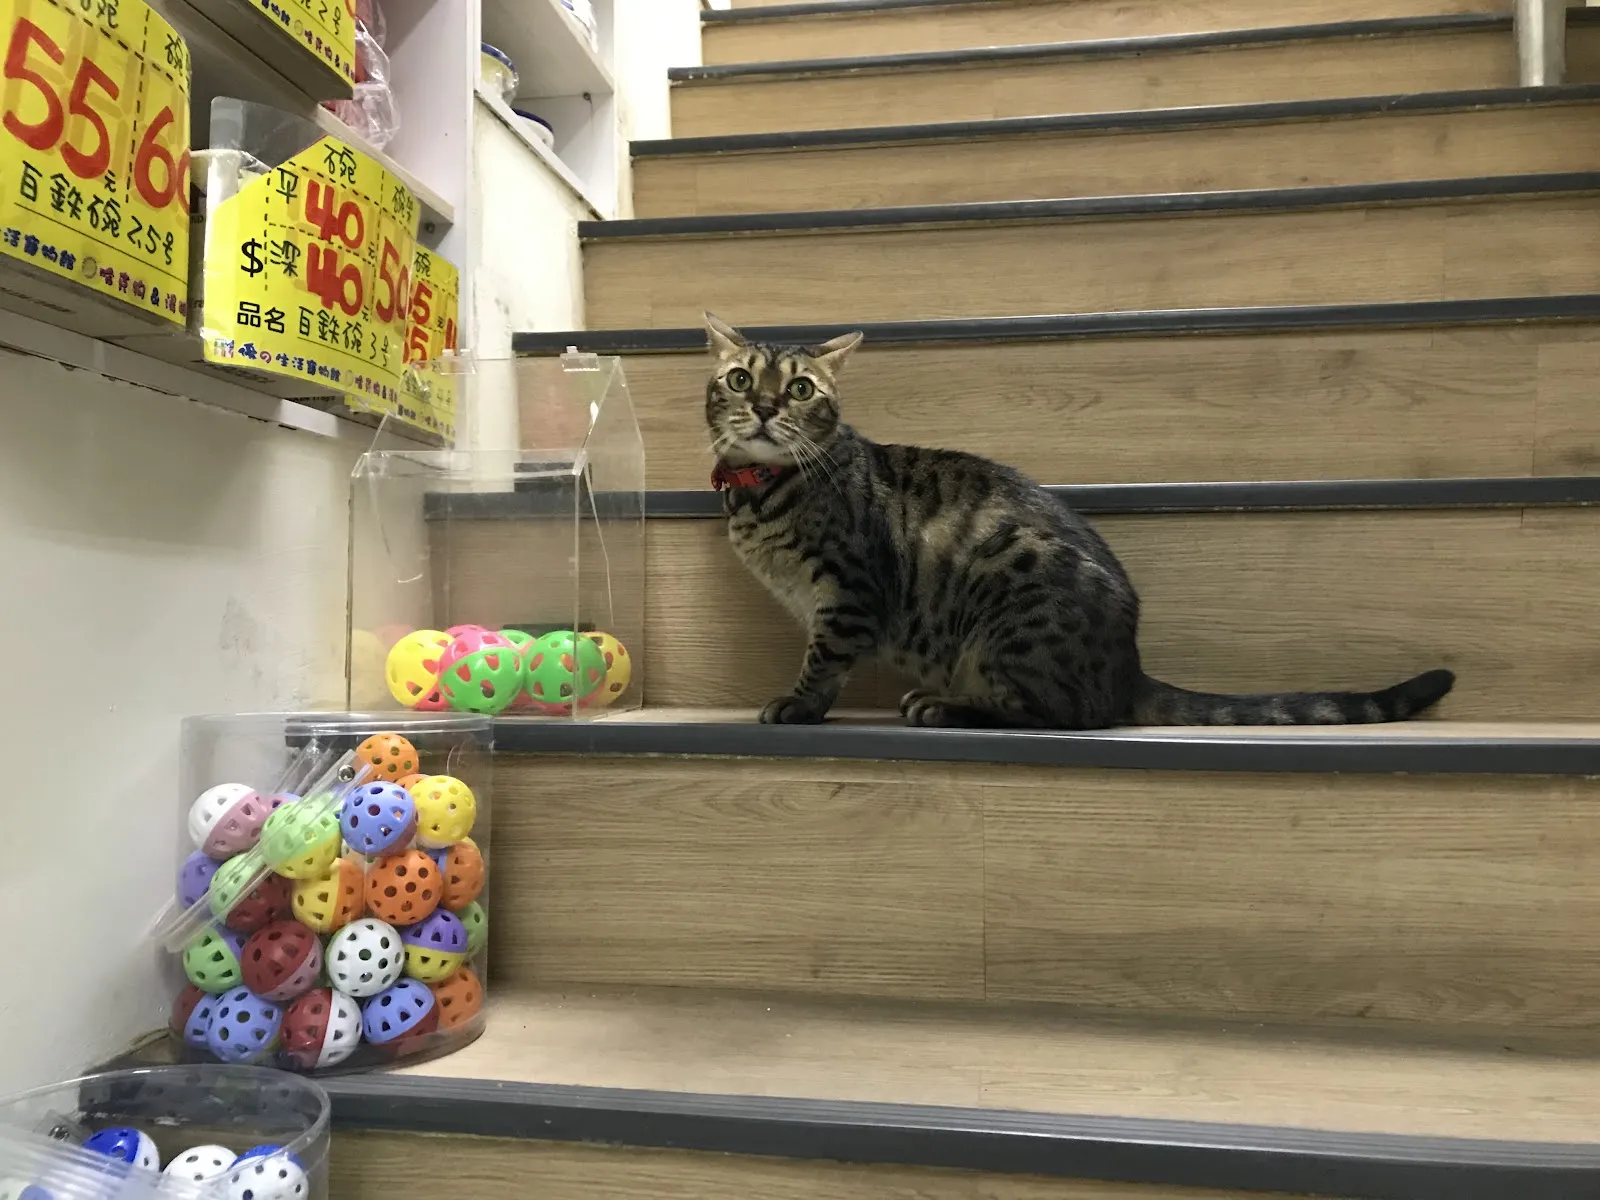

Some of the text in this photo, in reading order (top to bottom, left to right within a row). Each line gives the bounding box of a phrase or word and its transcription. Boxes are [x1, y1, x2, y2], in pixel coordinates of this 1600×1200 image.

[3, 16, 120, 179] 55
[324, 144, 357, 184] 碗
[276, 167, 298, 205] 平
[305, 178, 365, 250] 40
[240, 238, 264, 278] $
[306, 242, 364, 317] 40
[236, 300, 286, 335] 品名
